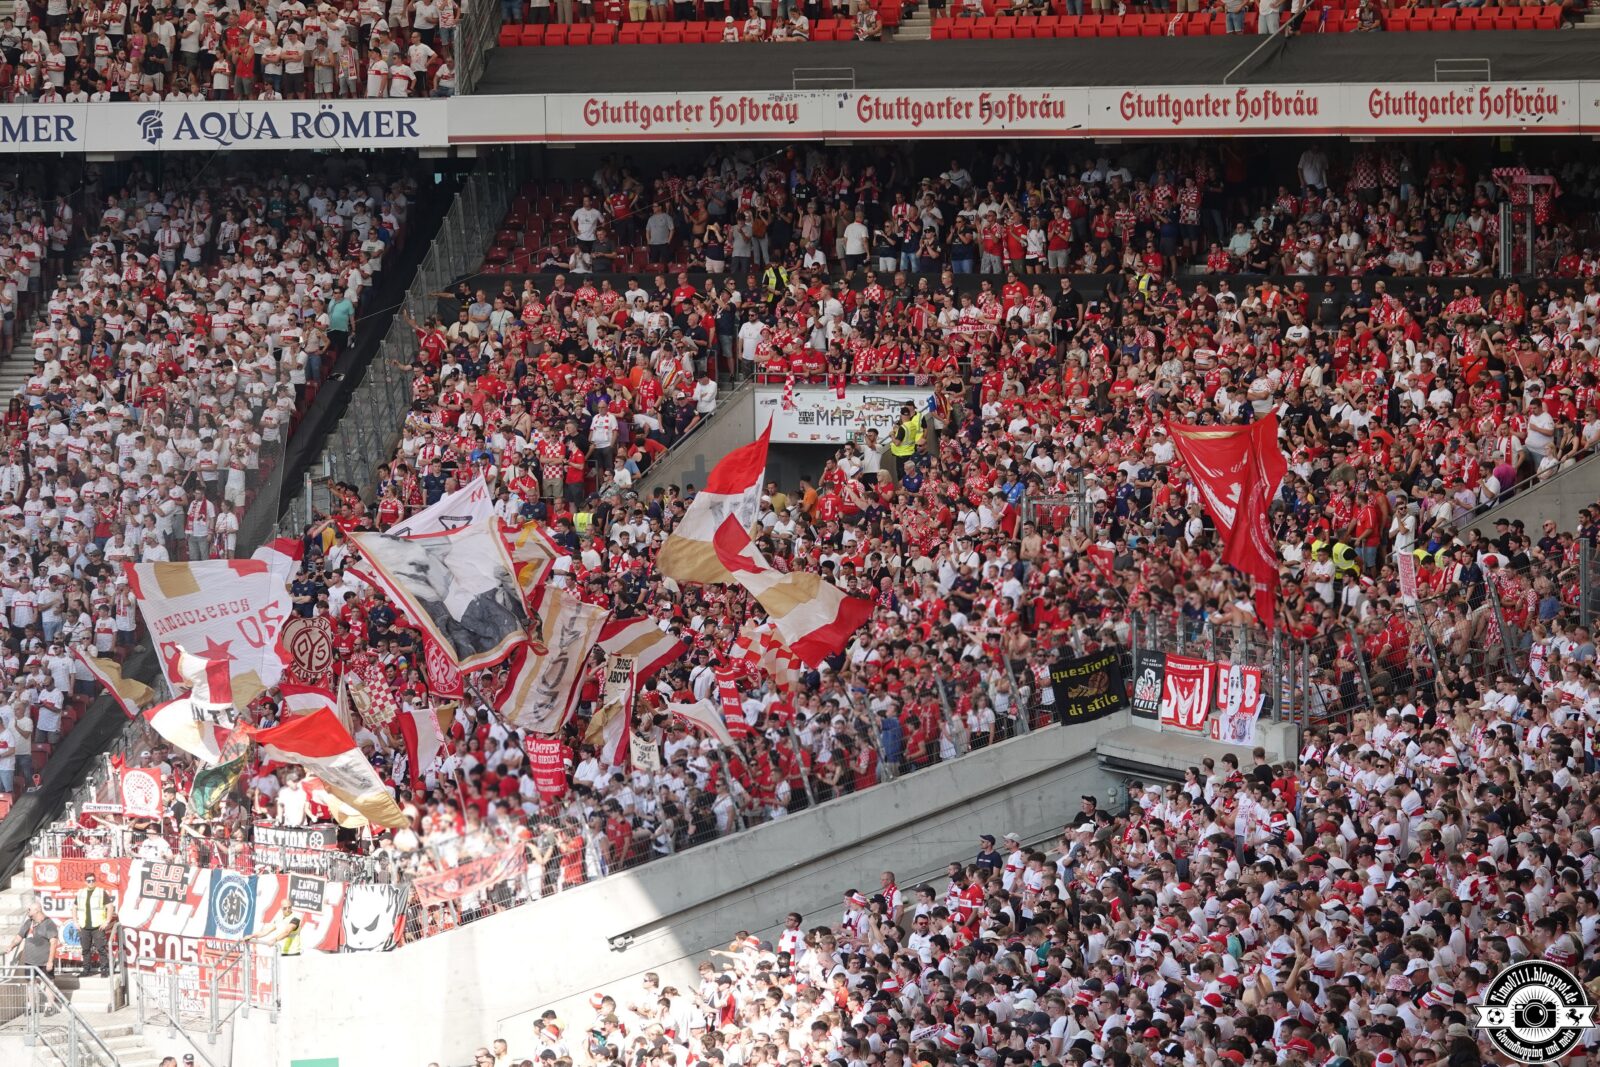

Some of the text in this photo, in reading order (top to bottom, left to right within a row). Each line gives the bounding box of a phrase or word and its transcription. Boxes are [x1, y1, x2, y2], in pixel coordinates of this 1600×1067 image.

[583, 98, 704, 129] Stuttgarter
[856, 93, 1066, 127] Stuttgarter Hofbräu
[1119, 89, 1318, 125] Stuttgarter Hofbräu
[1368, 86, 1558, 123] Stuttgarter Hofbräu
[0, 115, 78, 143] MER
[172, 103, 420, 147] AQUA RÖMER
[1051, 653, 1117, 682] questione
[191, 702, 238, 725] INTE
[1069, 694, 1120, 717] di stile
[151, 863, 185, 882] SUB
[142, 879, 188, 900] CIETY
